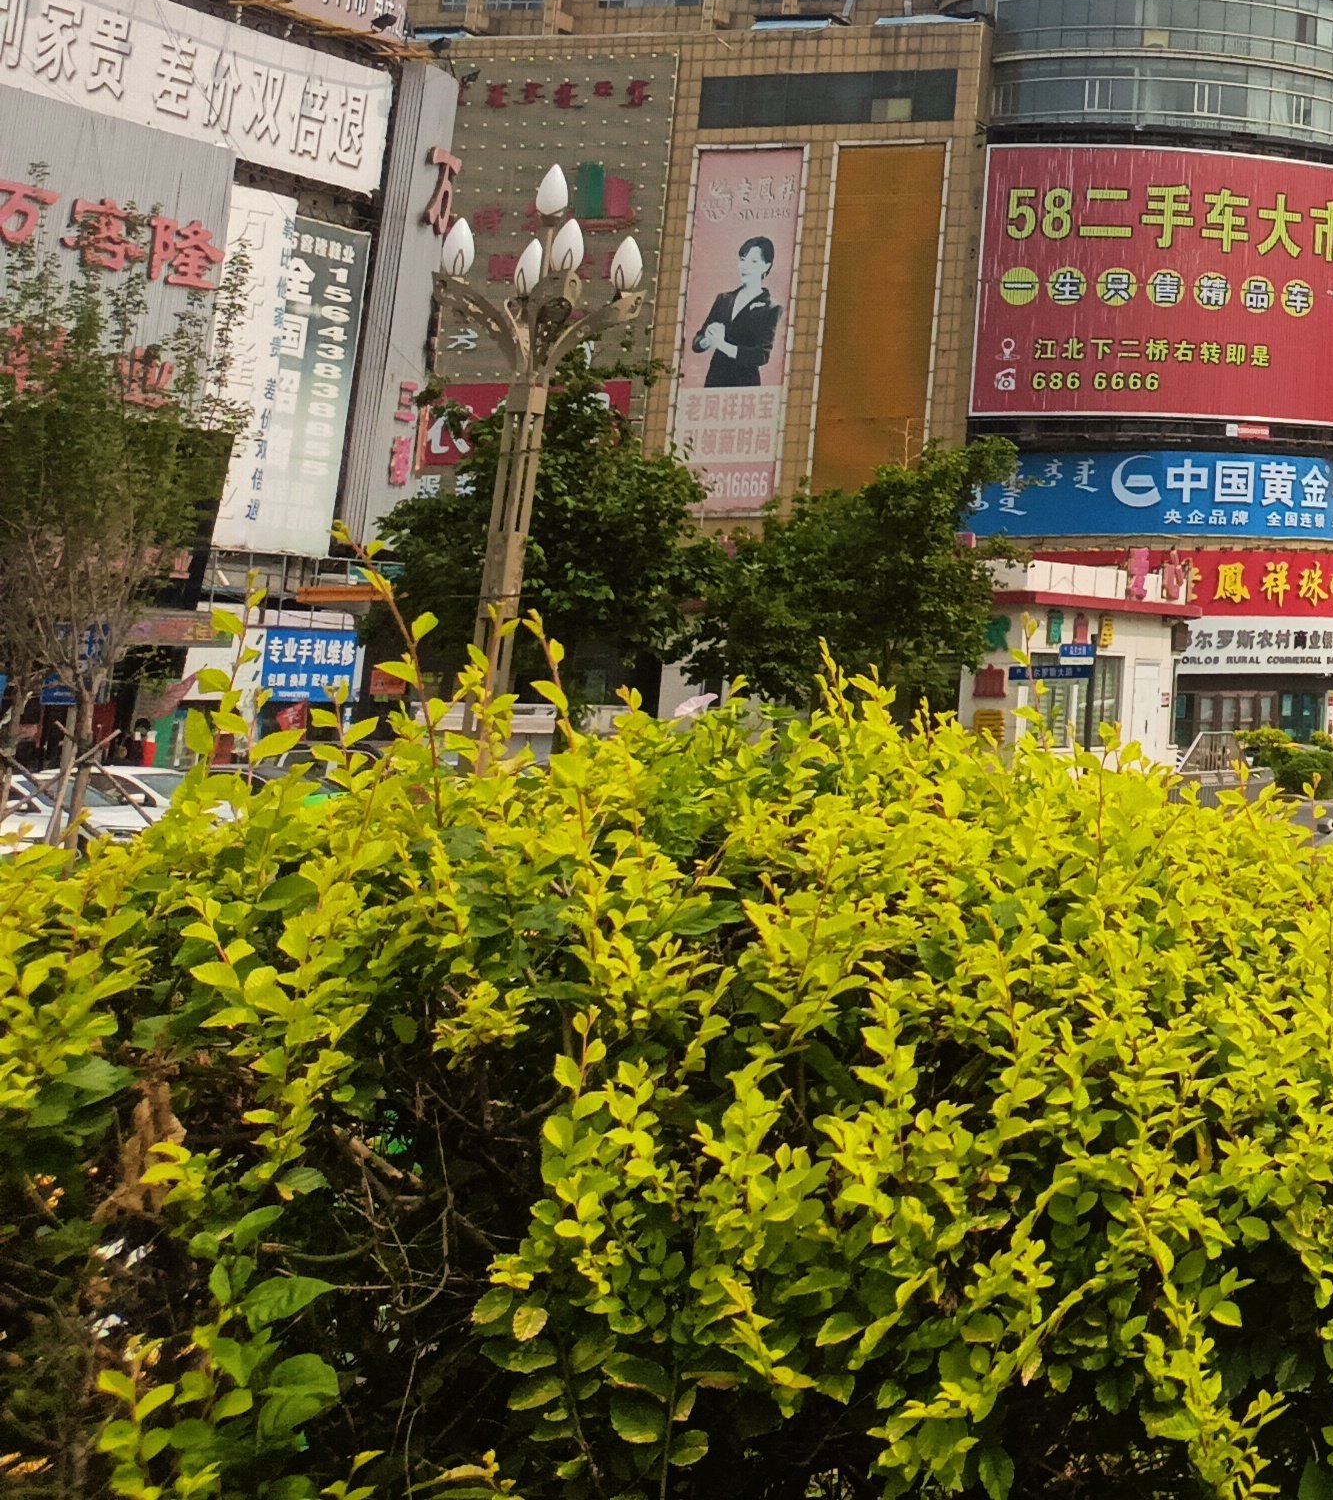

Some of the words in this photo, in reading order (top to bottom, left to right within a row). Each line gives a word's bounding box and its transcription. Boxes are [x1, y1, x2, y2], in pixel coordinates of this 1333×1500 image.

[154, 34, 369, 169] 差价双倍退
[1002, 269, 1313, 316] 一生只售精品车
[1034, 336, 1272, 368] 江北下二桥右转即是
[1031, 371, 1081, 391] 686
[1093, 371, 1161, 391] 6666
[1166, 458, 1331, 509] 中国黄金
[1164, 508, 1249, 526] 央企品牌
[1266, 511, 1326, 529] 全国连锁
[268, 636, 356, 667] 专业手机维修
[1226, 655, 1261, 665] RURAL
